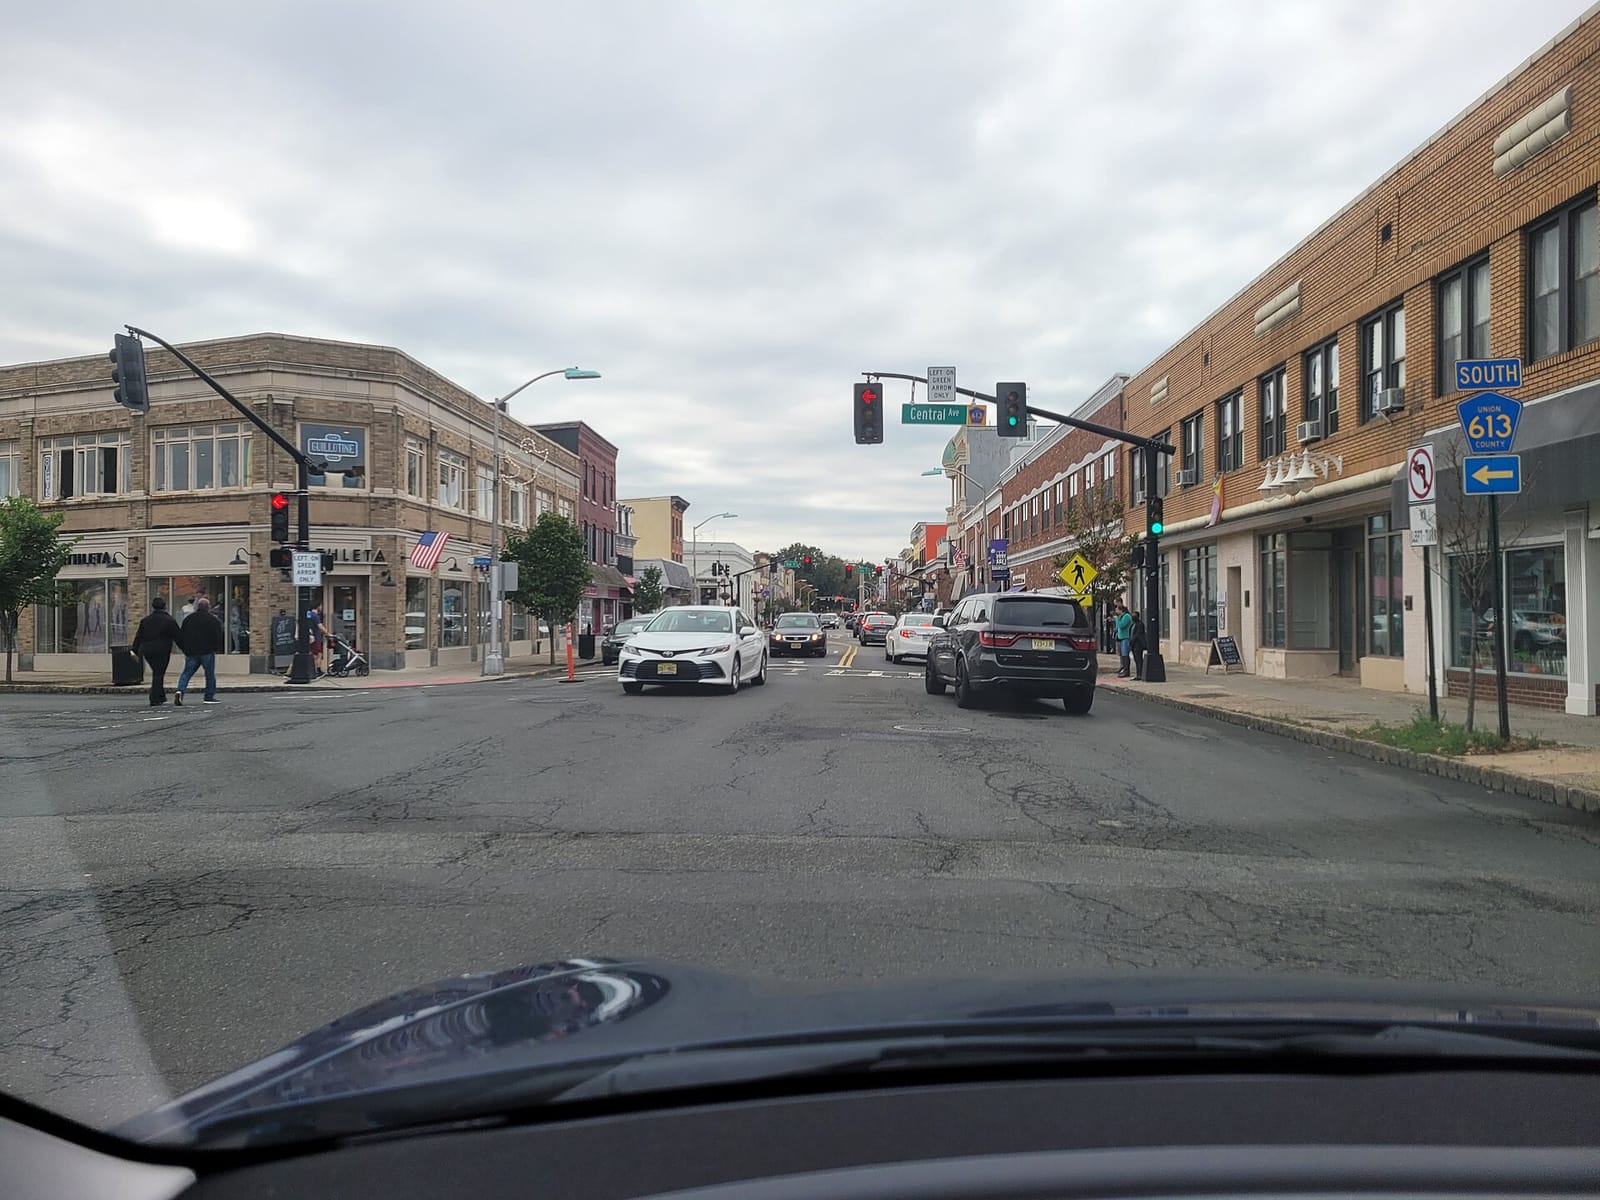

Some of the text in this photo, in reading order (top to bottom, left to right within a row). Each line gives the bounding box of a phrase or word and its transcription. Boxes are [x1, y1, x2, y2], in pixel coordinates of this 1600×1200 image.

[1460, 364, 1518, 384] SOUTH
[910, 407, 946, 421] Central
[1477, 405, 1501, 413] UNION
[1468, 414, 1512, 439] 613
[315, 547, 385, 562] HLETA
